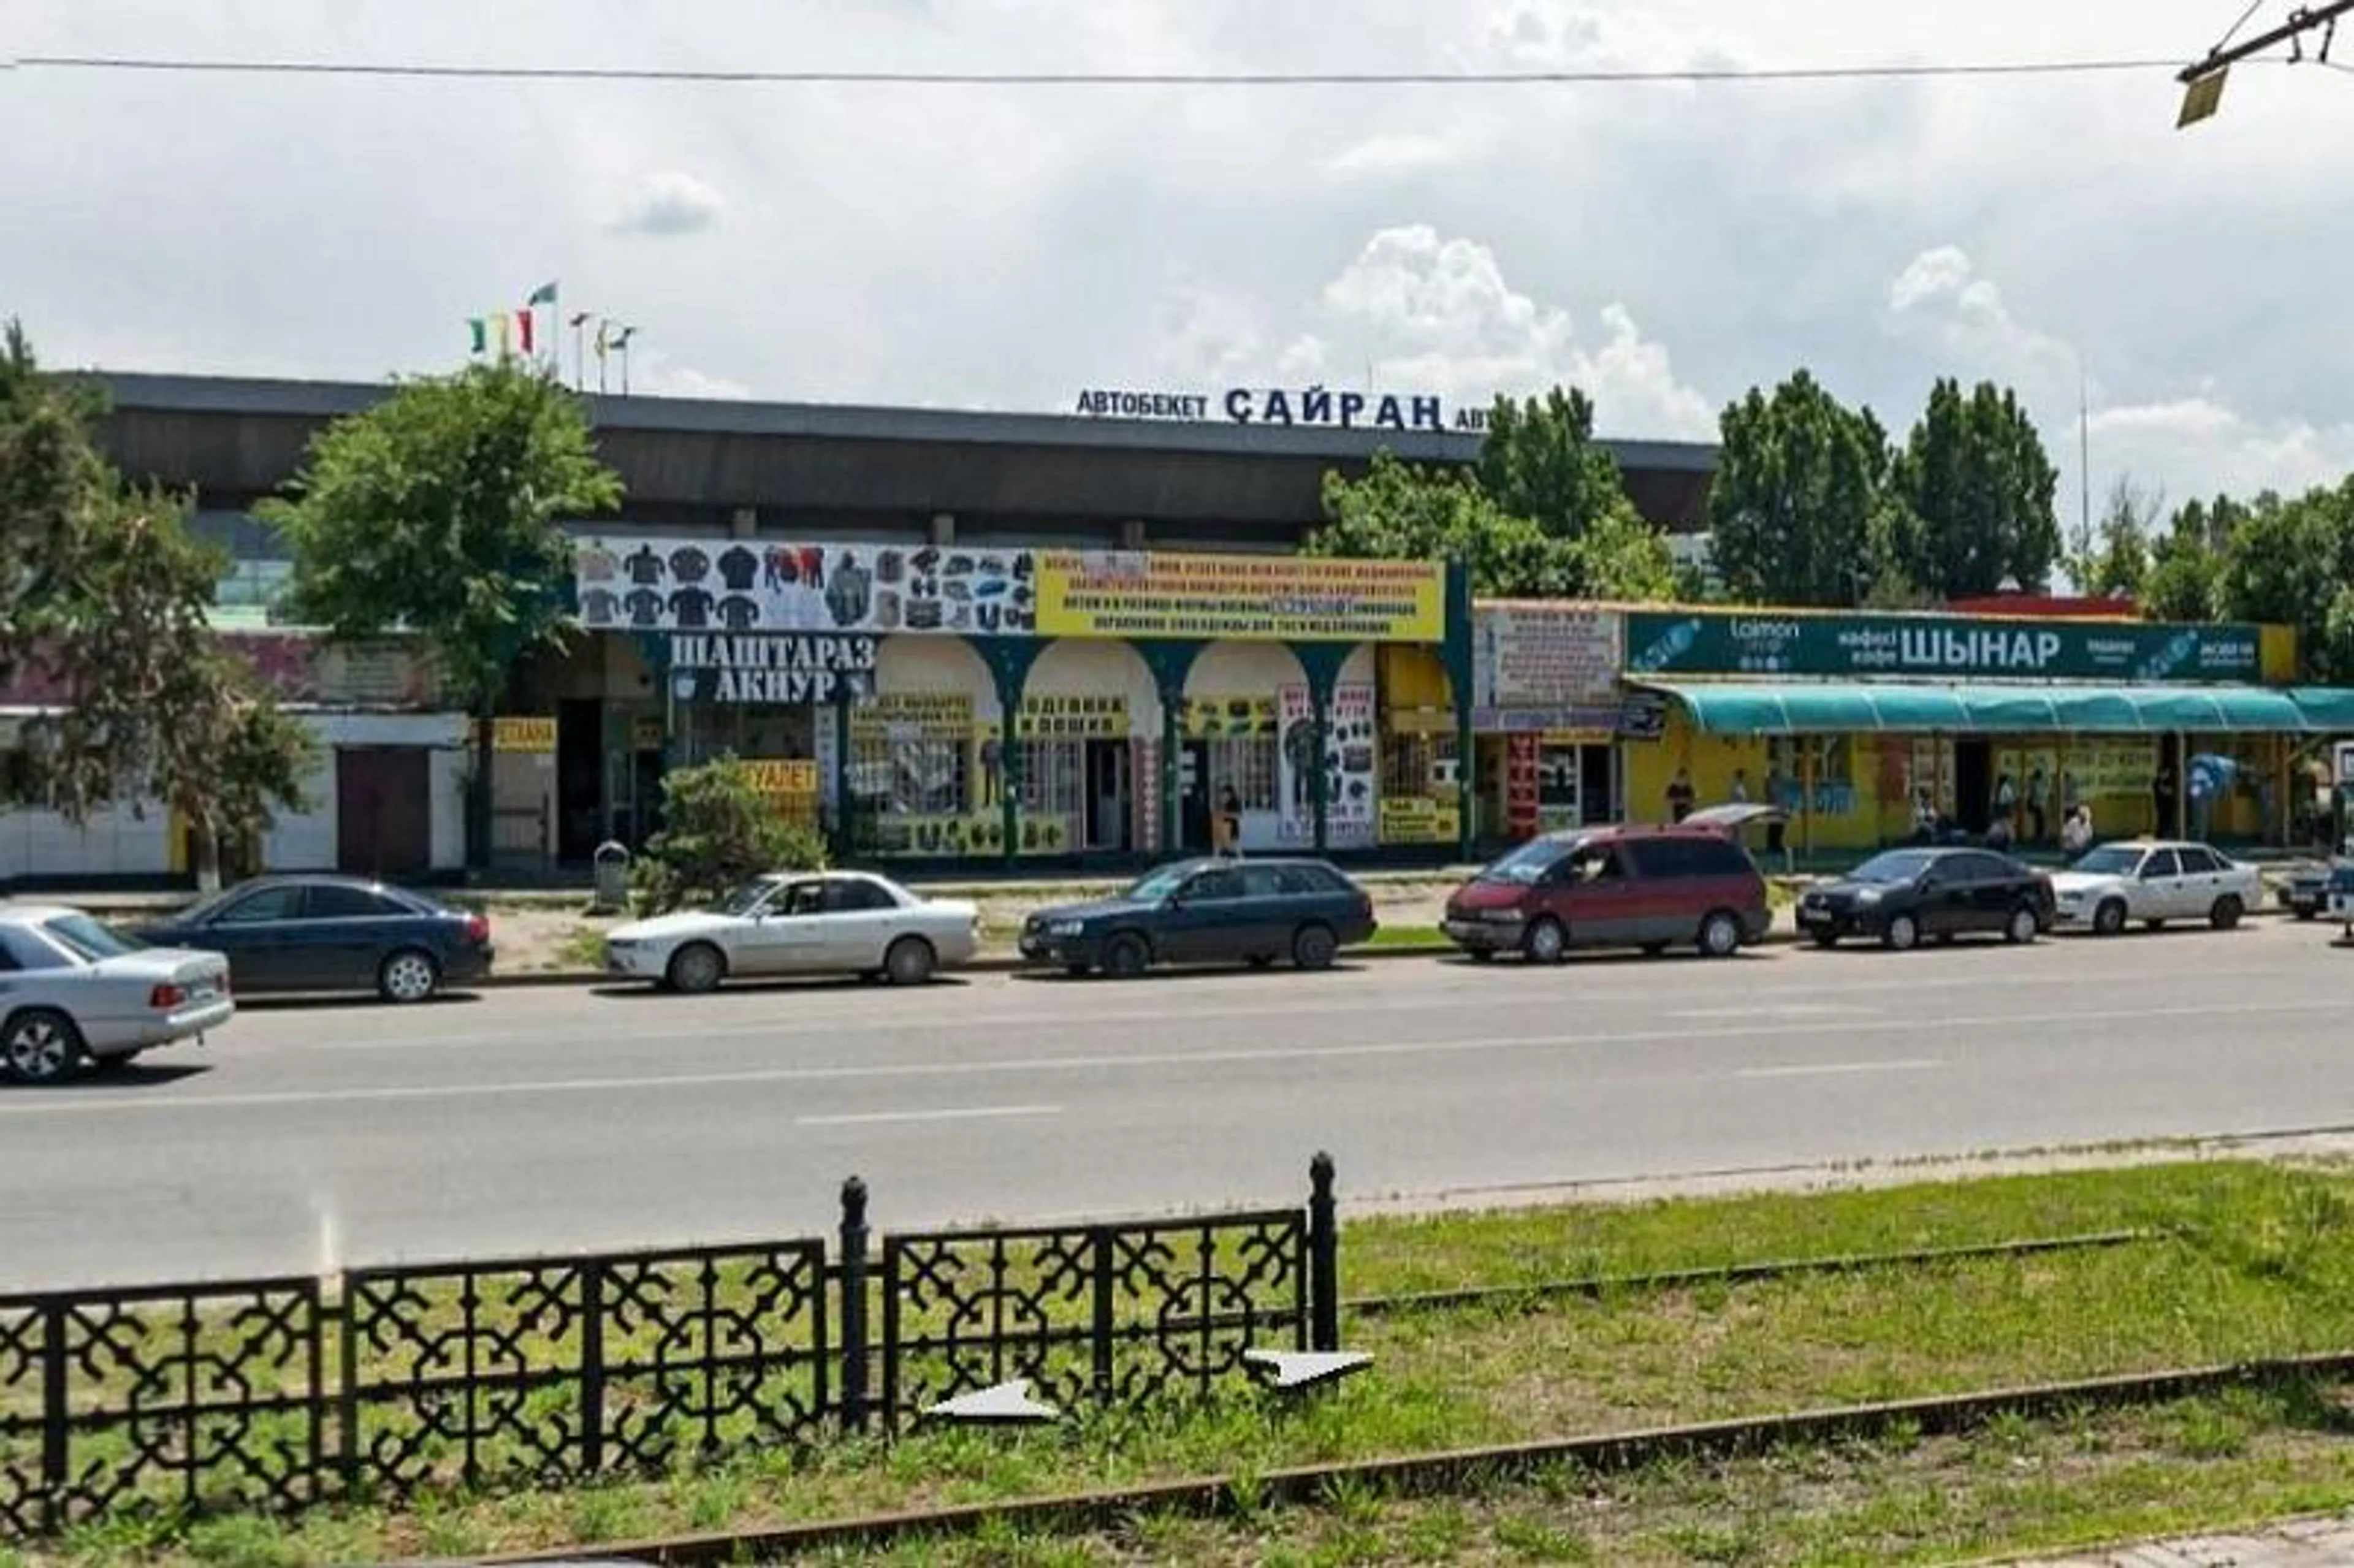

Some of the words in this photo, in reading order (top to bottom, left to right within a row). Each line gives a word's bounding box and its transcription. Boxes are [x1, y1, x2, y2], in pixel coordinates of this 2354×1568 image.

[1077, 389, 1208, 417] АВТОБЕКЕТ
[671, 635, 874, 670] ШАШТАРАЗ
[1902, 629, 2061, 668] ШЫНАР
